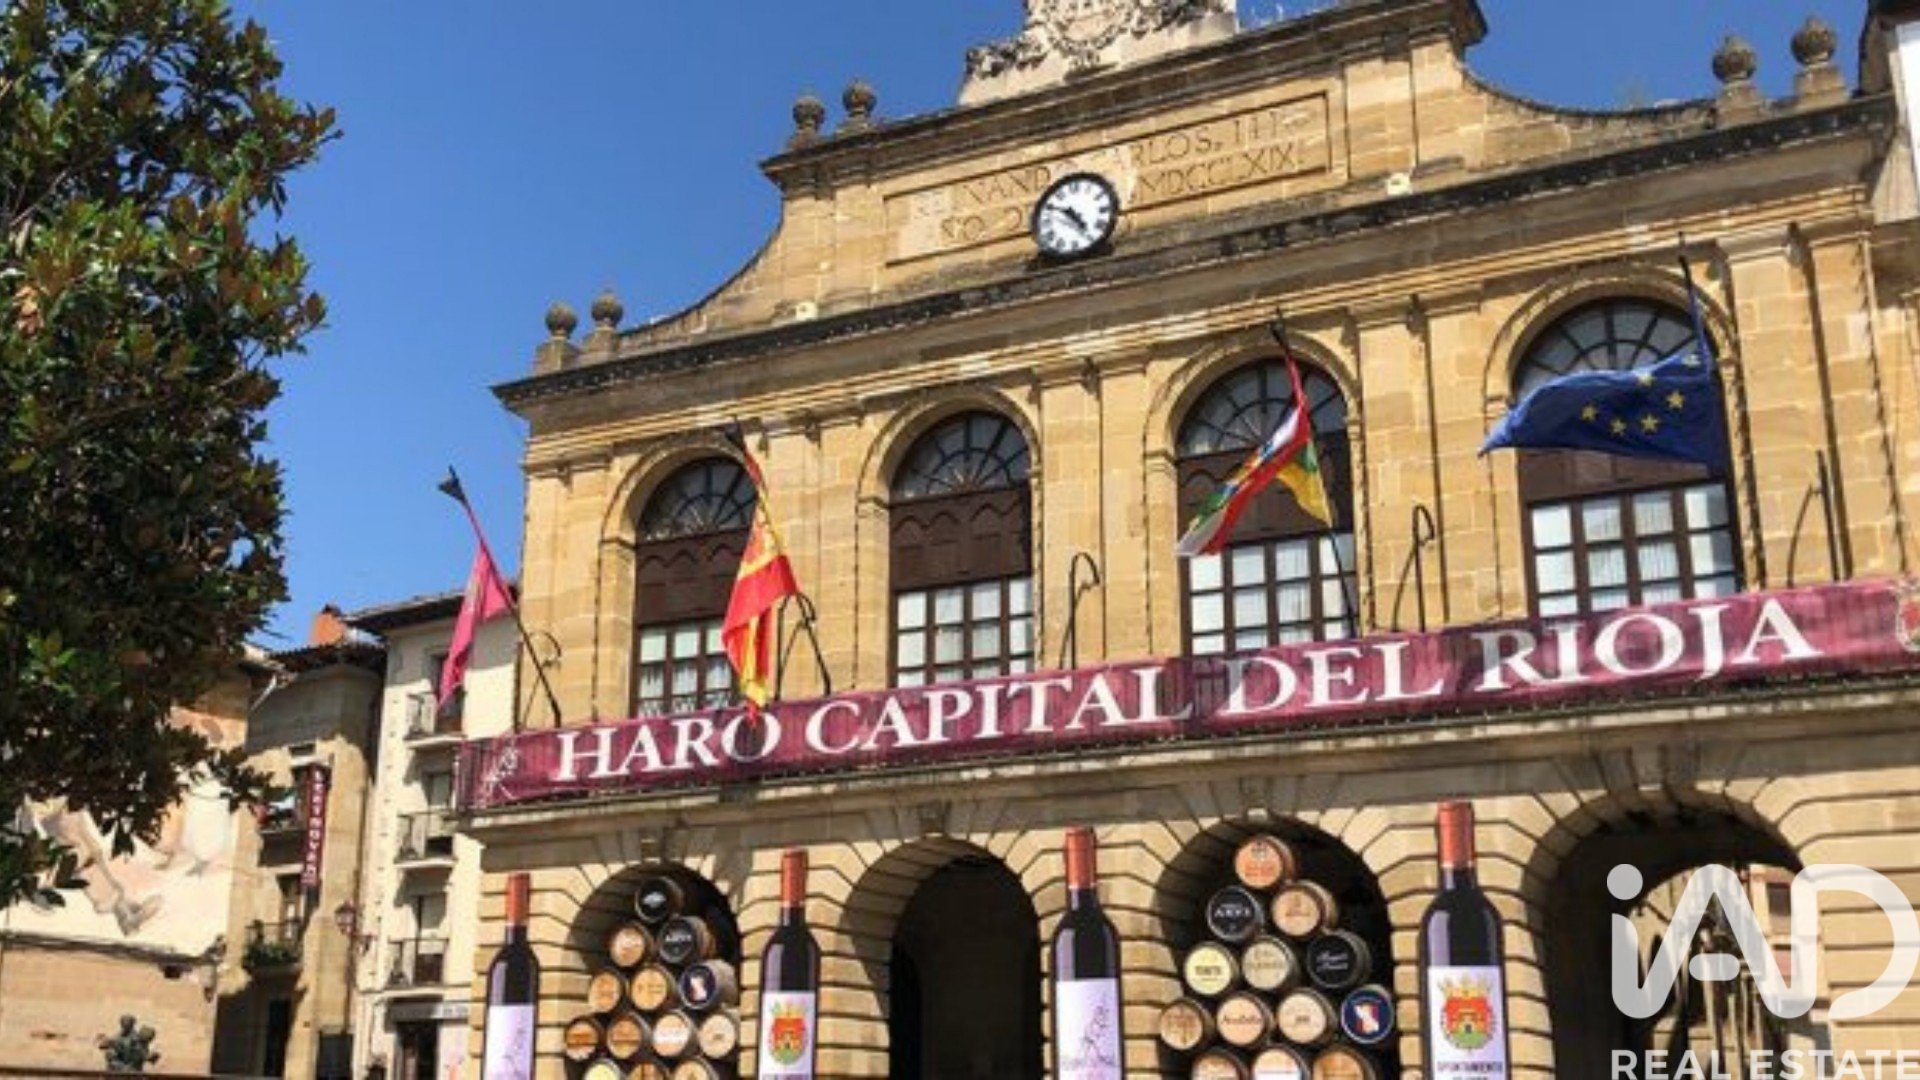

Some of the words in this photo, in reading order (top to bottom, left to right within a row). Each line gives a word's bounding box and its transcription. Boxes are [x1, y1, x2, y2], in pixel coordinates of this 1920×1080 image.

[553, 711, 782, 782] HARO
[803, 665, 1196, 754] CAPITAL
[1216, 640, 1444, 716] DEL
[1470, 598, 1824, 692] RIOJA
